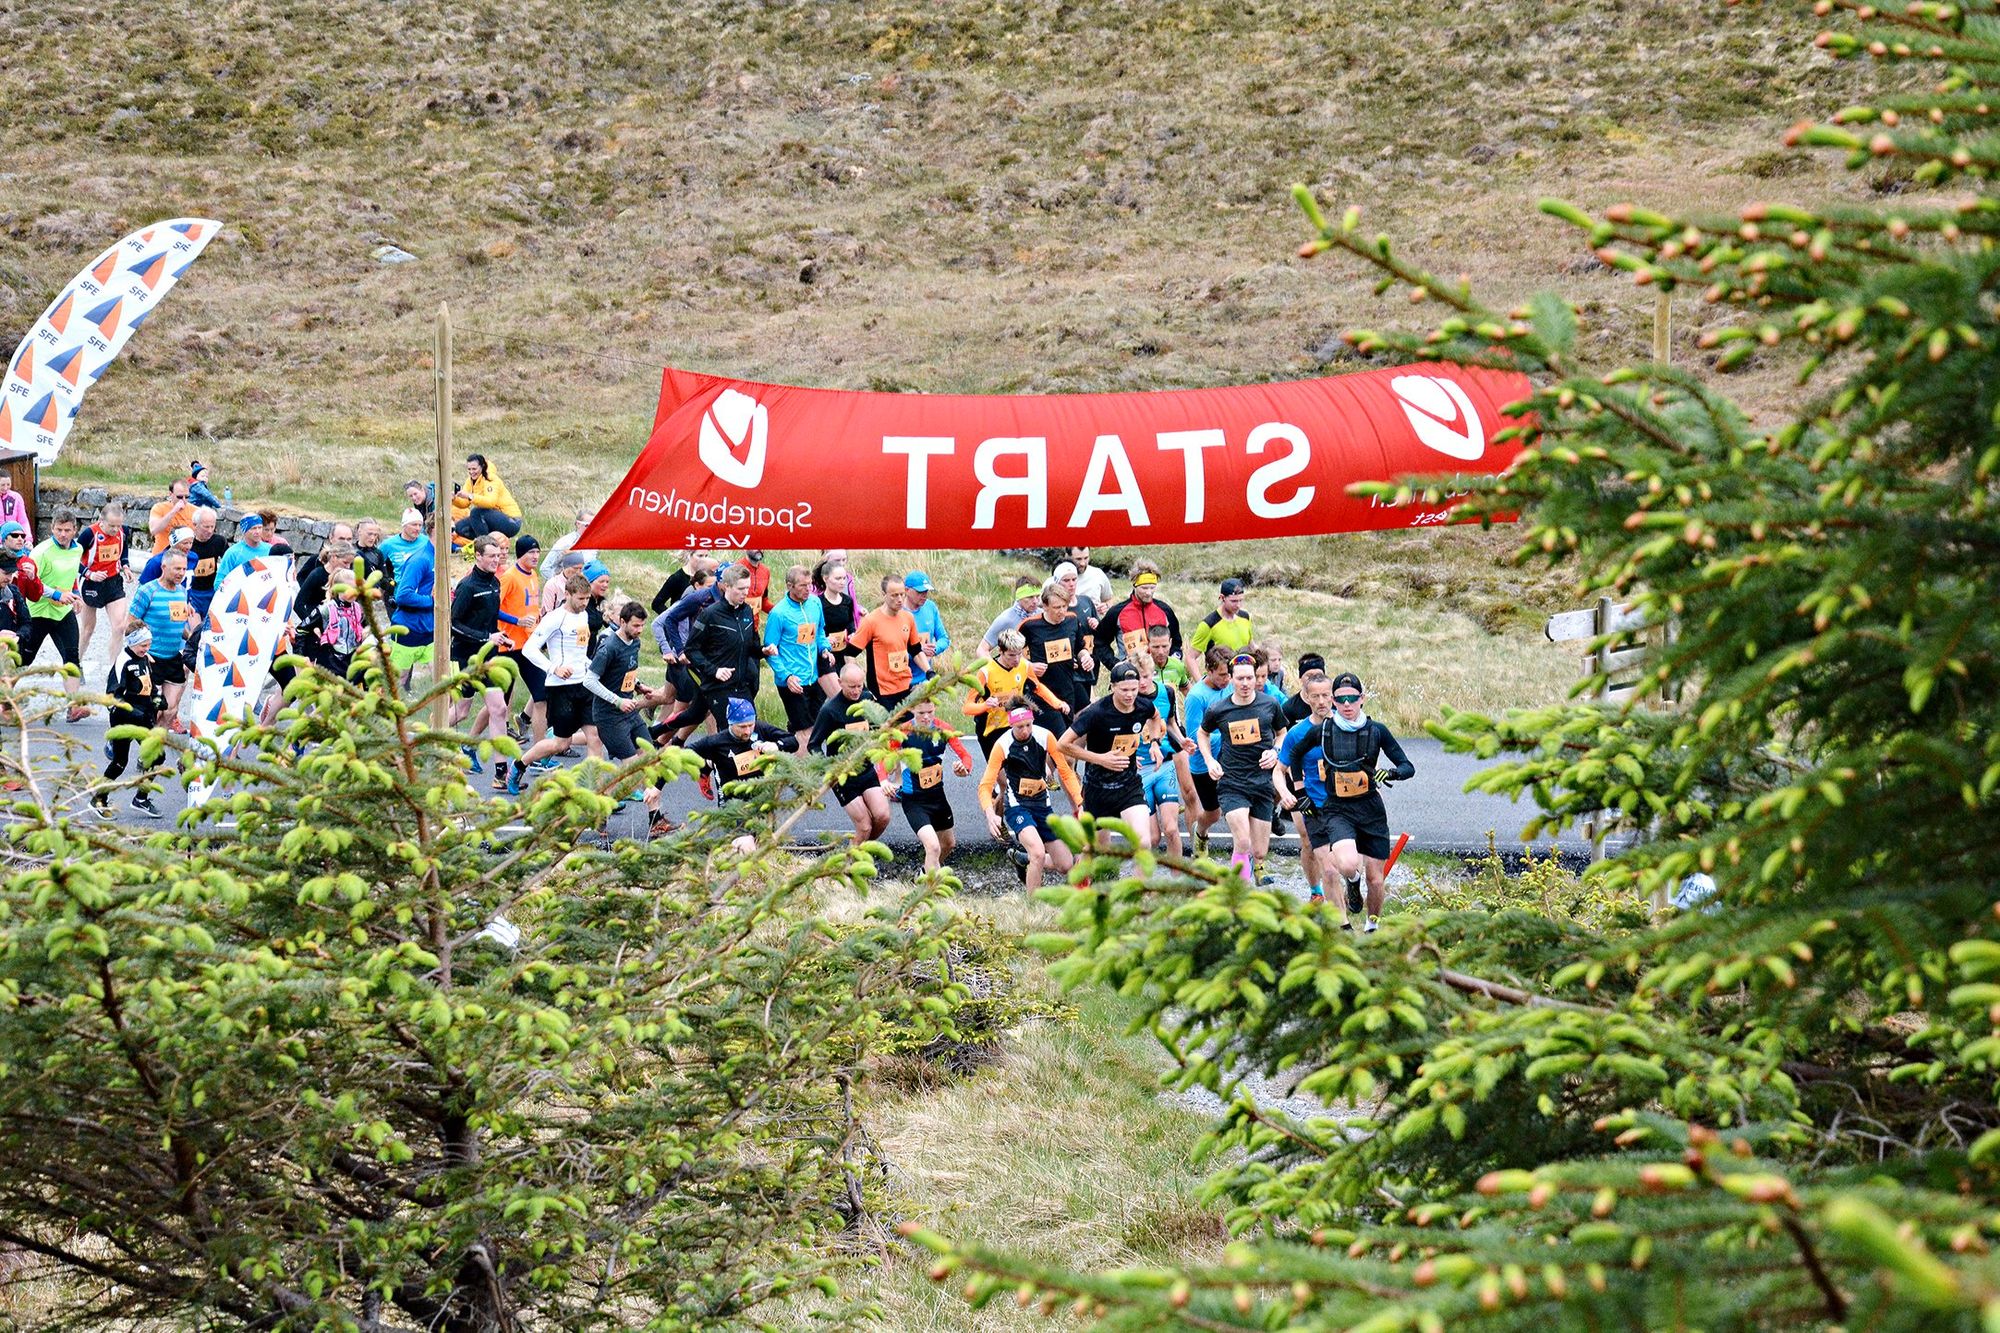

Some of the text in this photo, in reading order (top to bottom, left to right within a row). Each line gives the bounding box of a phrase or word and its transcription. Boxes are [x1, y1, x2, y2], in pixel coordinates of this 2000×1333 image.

[79, 280, 100, 297] SFE
[128, 286, 149, 303] SFE
[38, 329, 59, 346] SFE
[87, 335, 108, 353] SFE
[9, 383, 30, 398] SFE
[36, 434, 54, 446] SFE
[235, 618, 249, 626] SFE
[1127, 642, 1137, 650] 63
[1049, 651, 1060, 659] 55
[923, 777, 933, 785] 24
